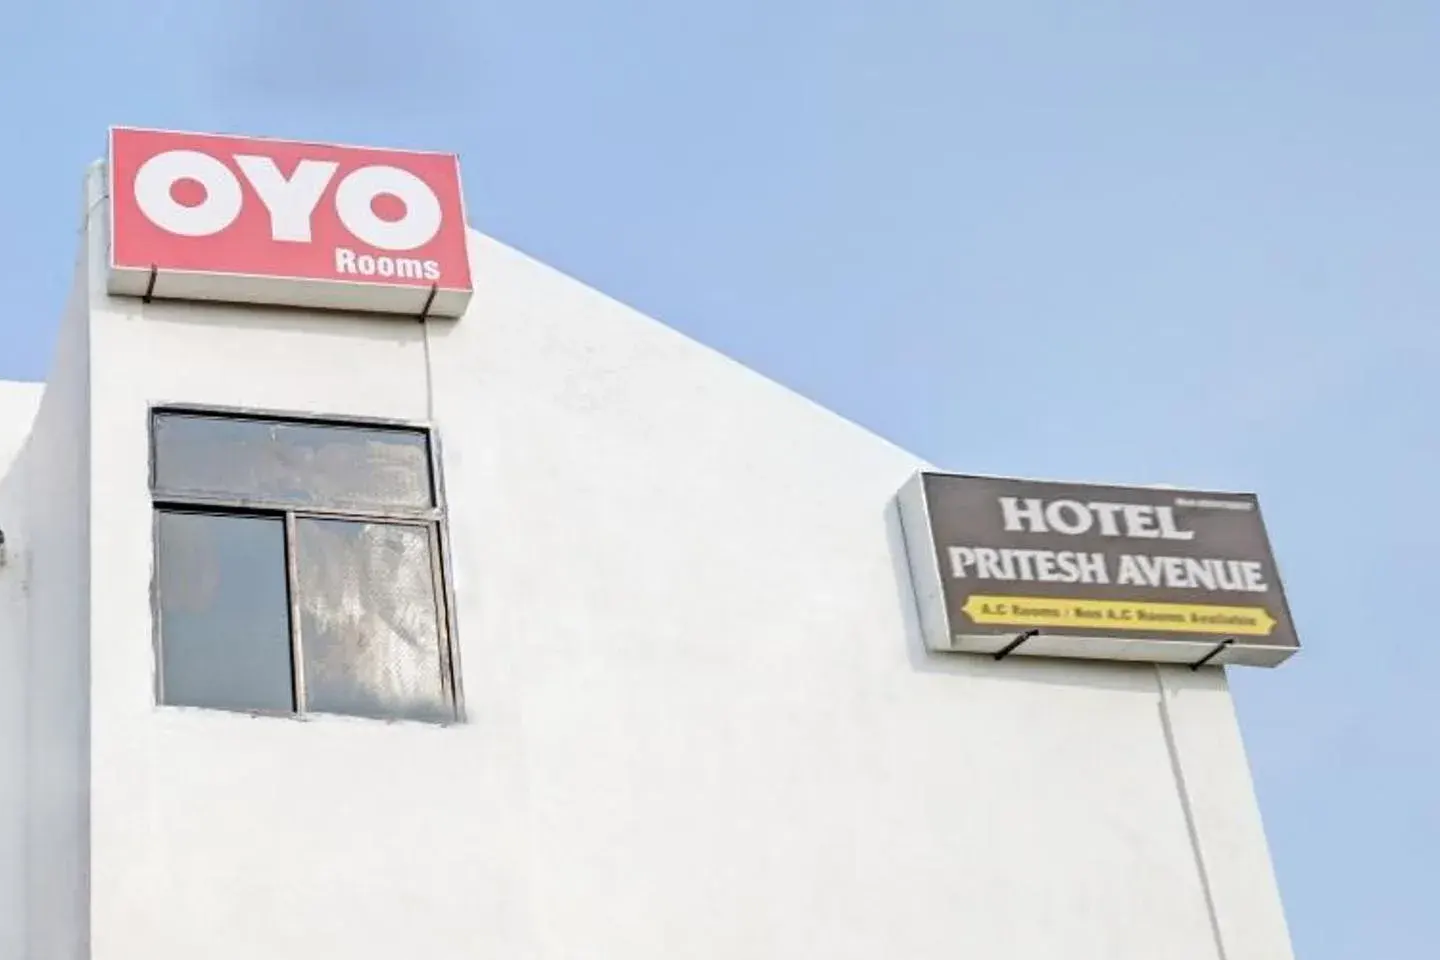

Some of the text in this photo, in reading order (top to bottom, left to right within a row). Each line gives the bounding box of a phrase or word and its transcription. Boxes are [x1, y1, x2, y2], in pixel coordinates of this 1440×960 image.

[133, 149, 443, 250] OYO
[334, 247, 441, 280] Rooms
[997, 496, 1195, 540] HOTEL
[947, 546, 1268, 592] PRITESH AVENUE
